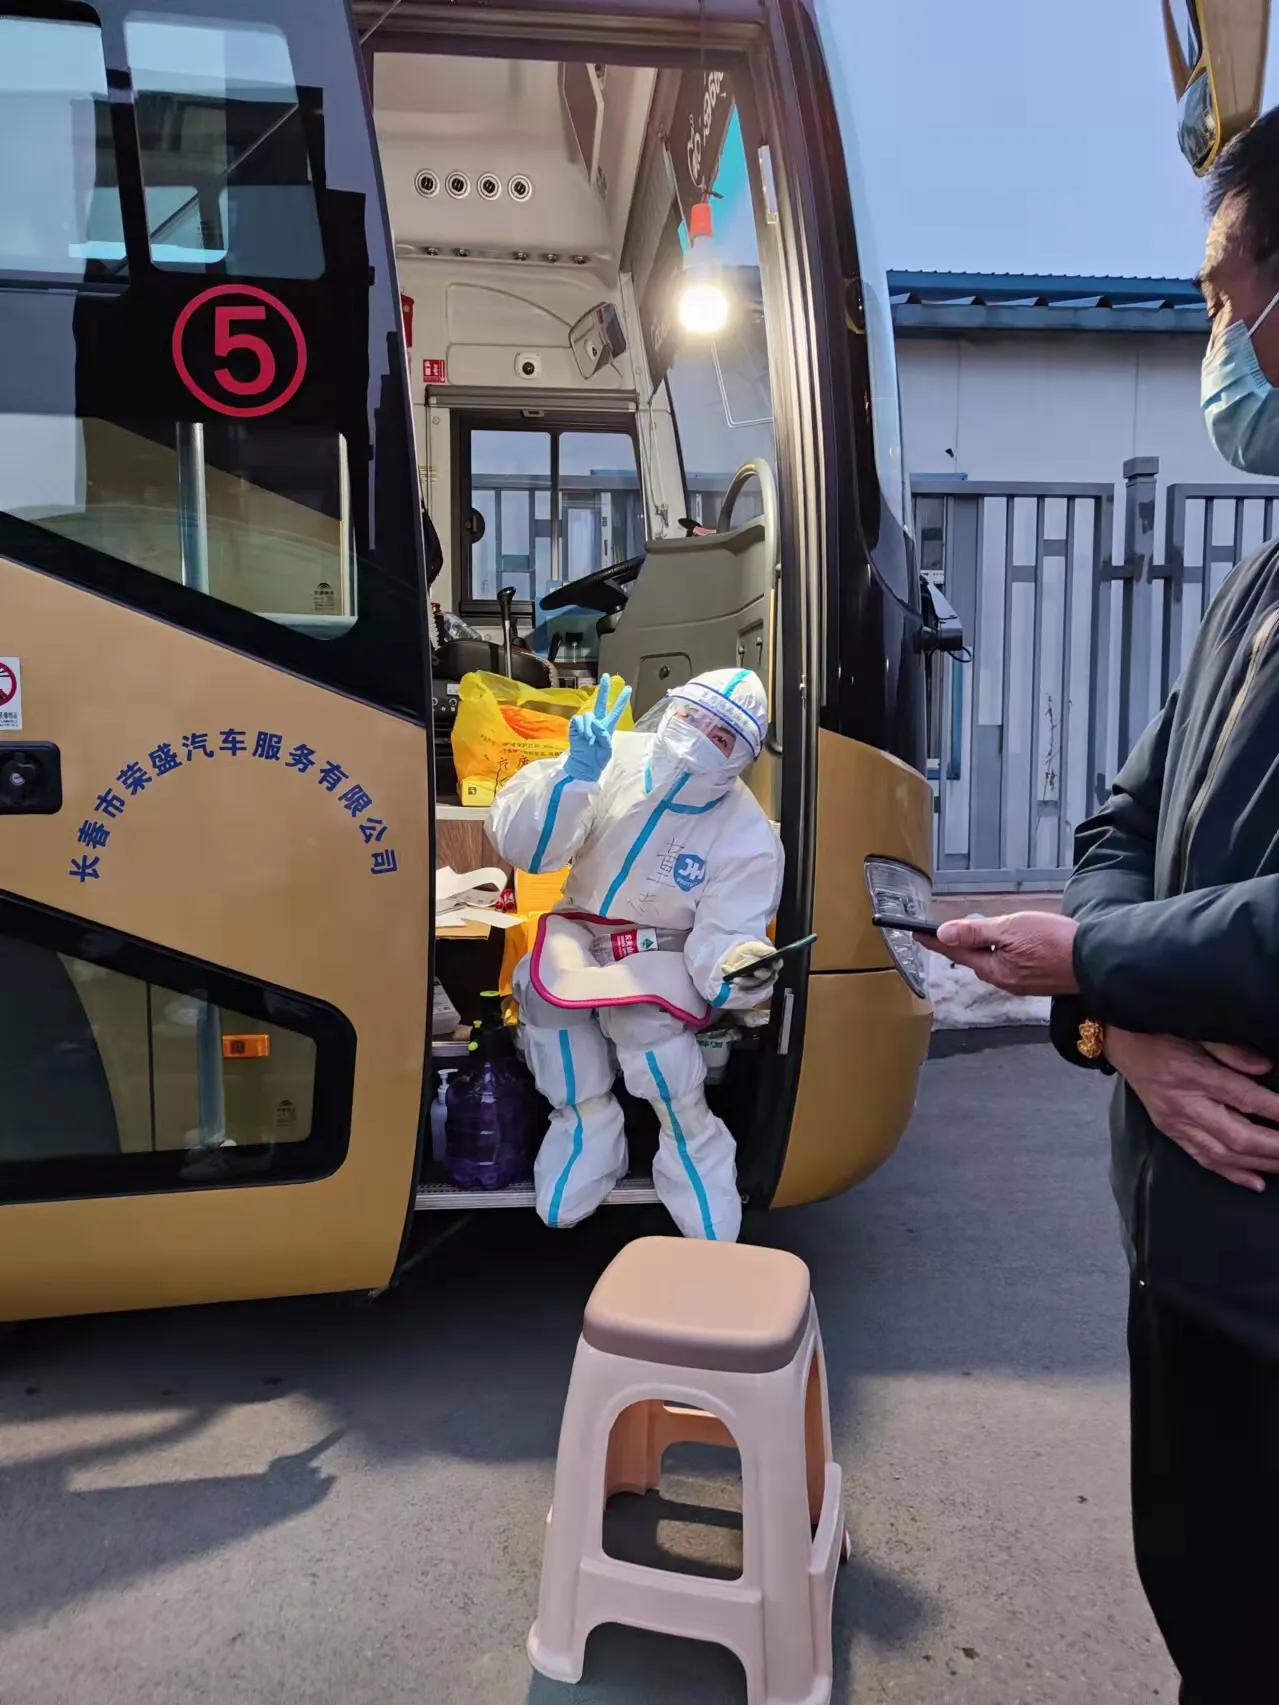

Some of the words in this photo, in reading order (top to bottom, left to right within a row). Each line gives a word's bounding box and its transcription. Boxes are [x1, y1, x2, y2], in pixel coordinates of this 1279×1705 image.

[214, 305, 276, 396] 5
[69, 727, 398, 883] 长春市荣盛汽车服务有限公司
